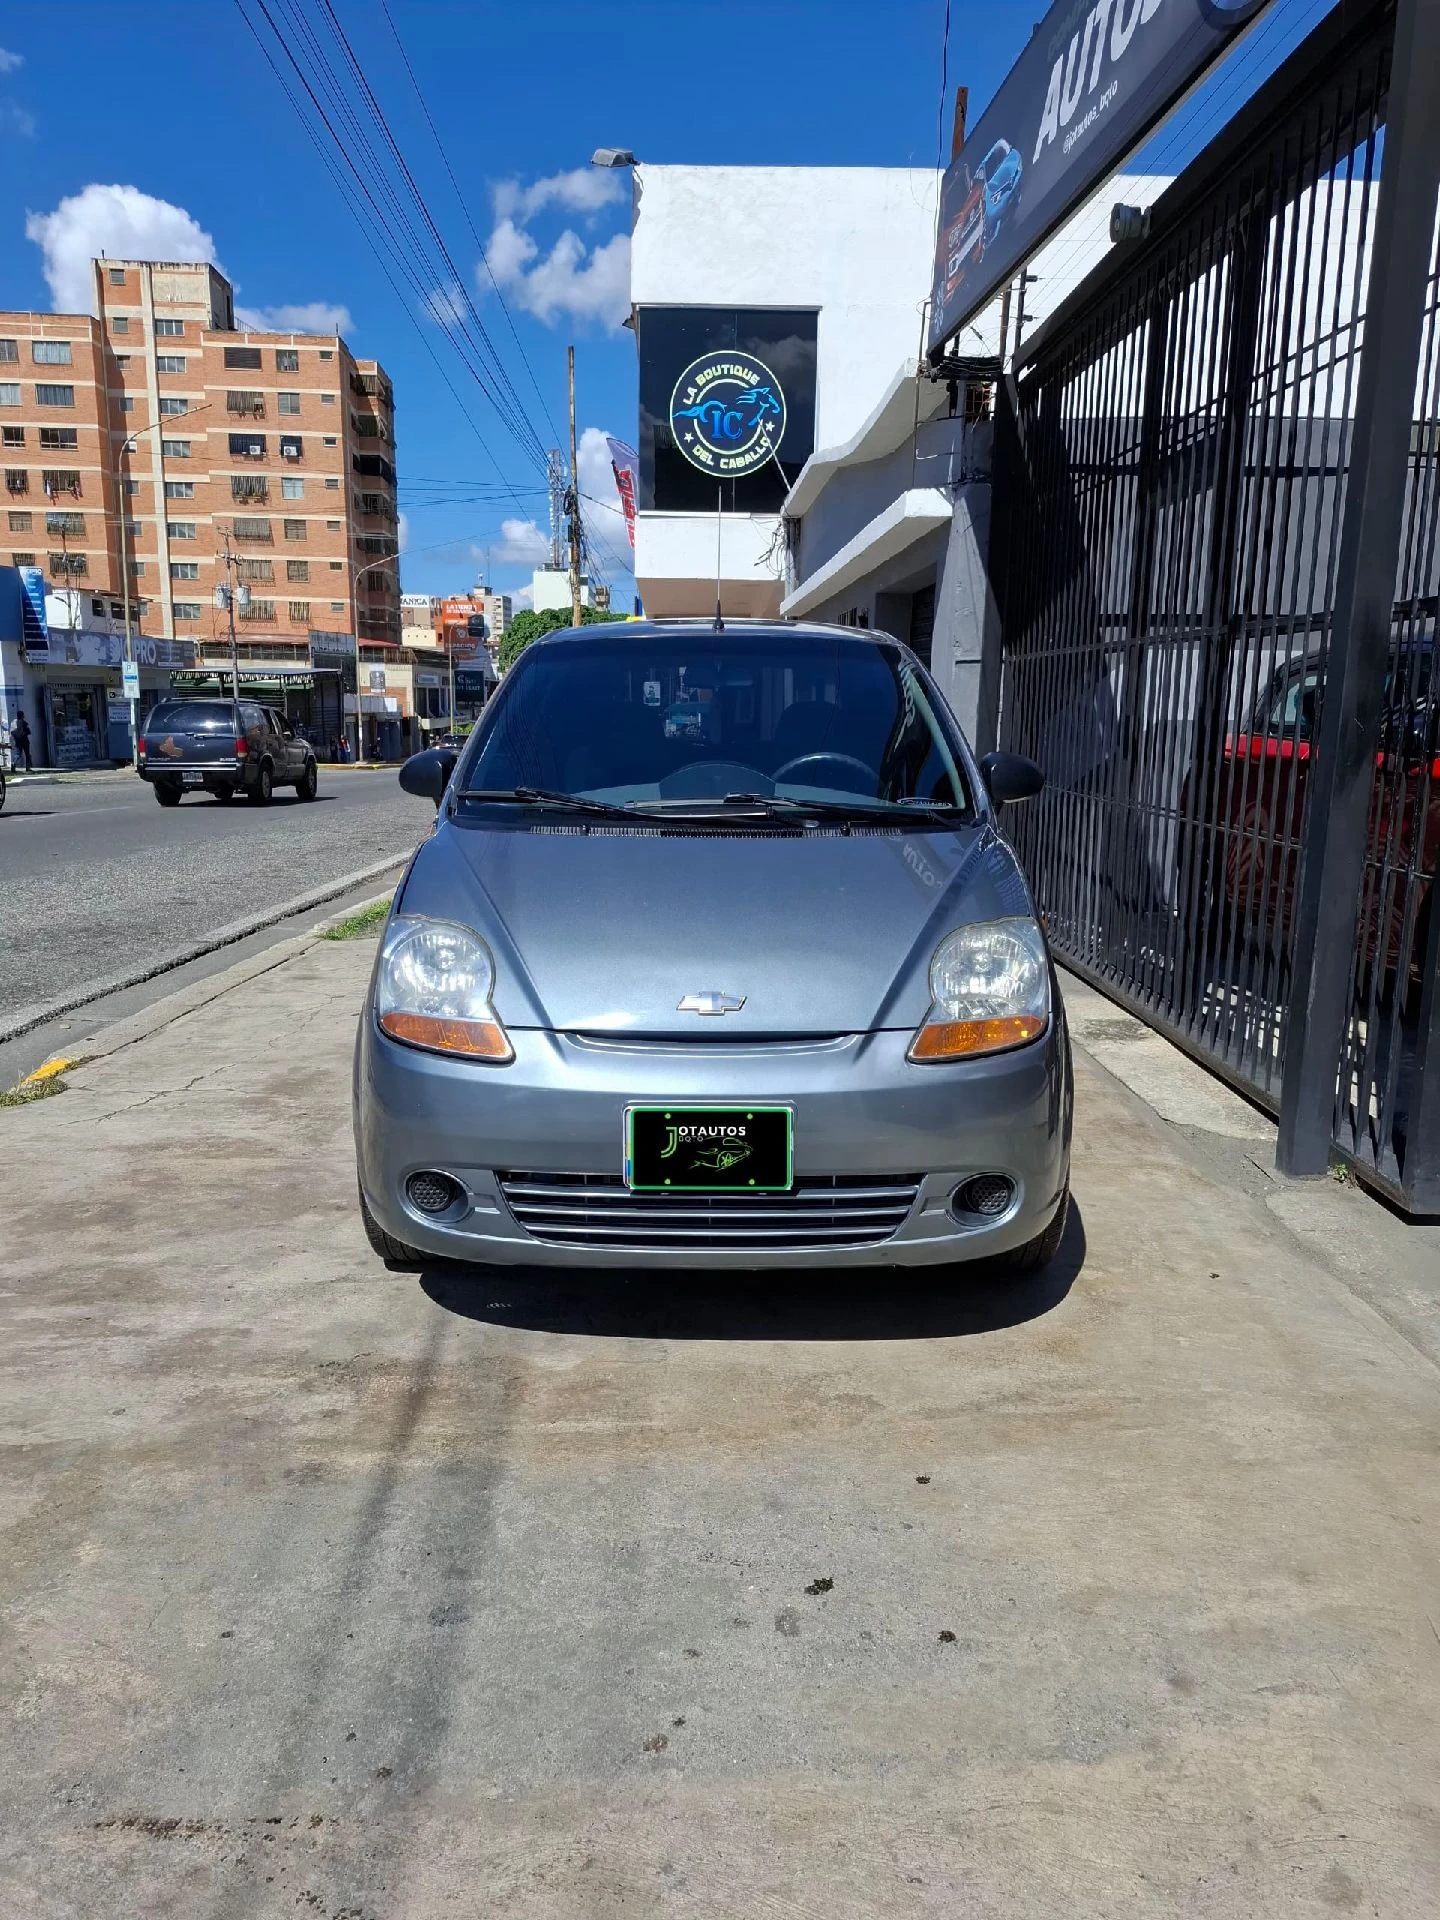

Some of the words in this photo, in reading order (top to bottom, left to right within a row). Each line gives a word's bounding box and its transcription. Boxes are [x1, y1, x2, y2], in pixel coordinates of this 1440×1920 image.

[683, 387, 698, 405] LA
[695, 365, 760, 386] BOUTIQUE
[711, 410, 743, 439] IC
[692, 444, 714, 466] DEL
[720, 436, 770, 469] CABALLO
